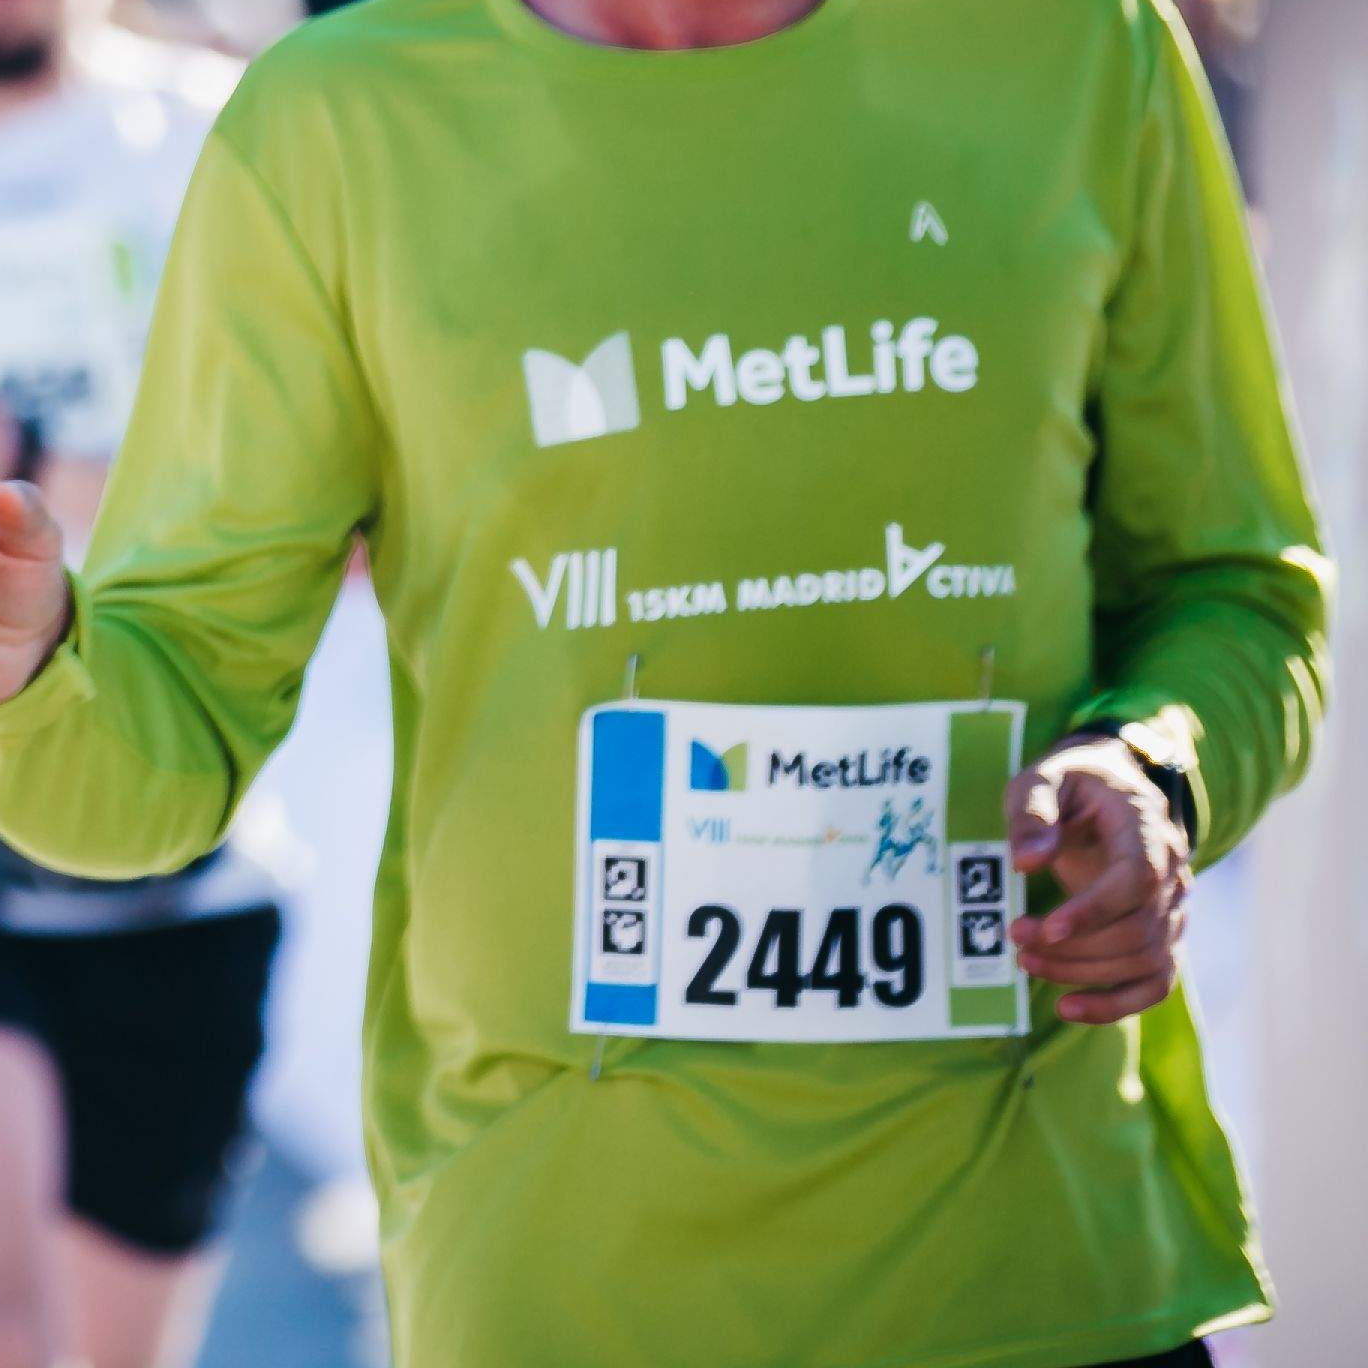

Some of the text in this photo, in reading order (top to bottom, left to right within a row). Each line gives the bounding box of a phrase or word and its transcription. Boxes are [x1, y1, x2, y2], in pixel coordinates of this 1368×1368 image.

[661, 317, 980, 412] MetLife
[509, 547, 618, 630] VIII
[625, 582, 728, 624] 15KM
[769, 746, 932, 790] MetLife
[684, 902, 924, 1009] 2449
